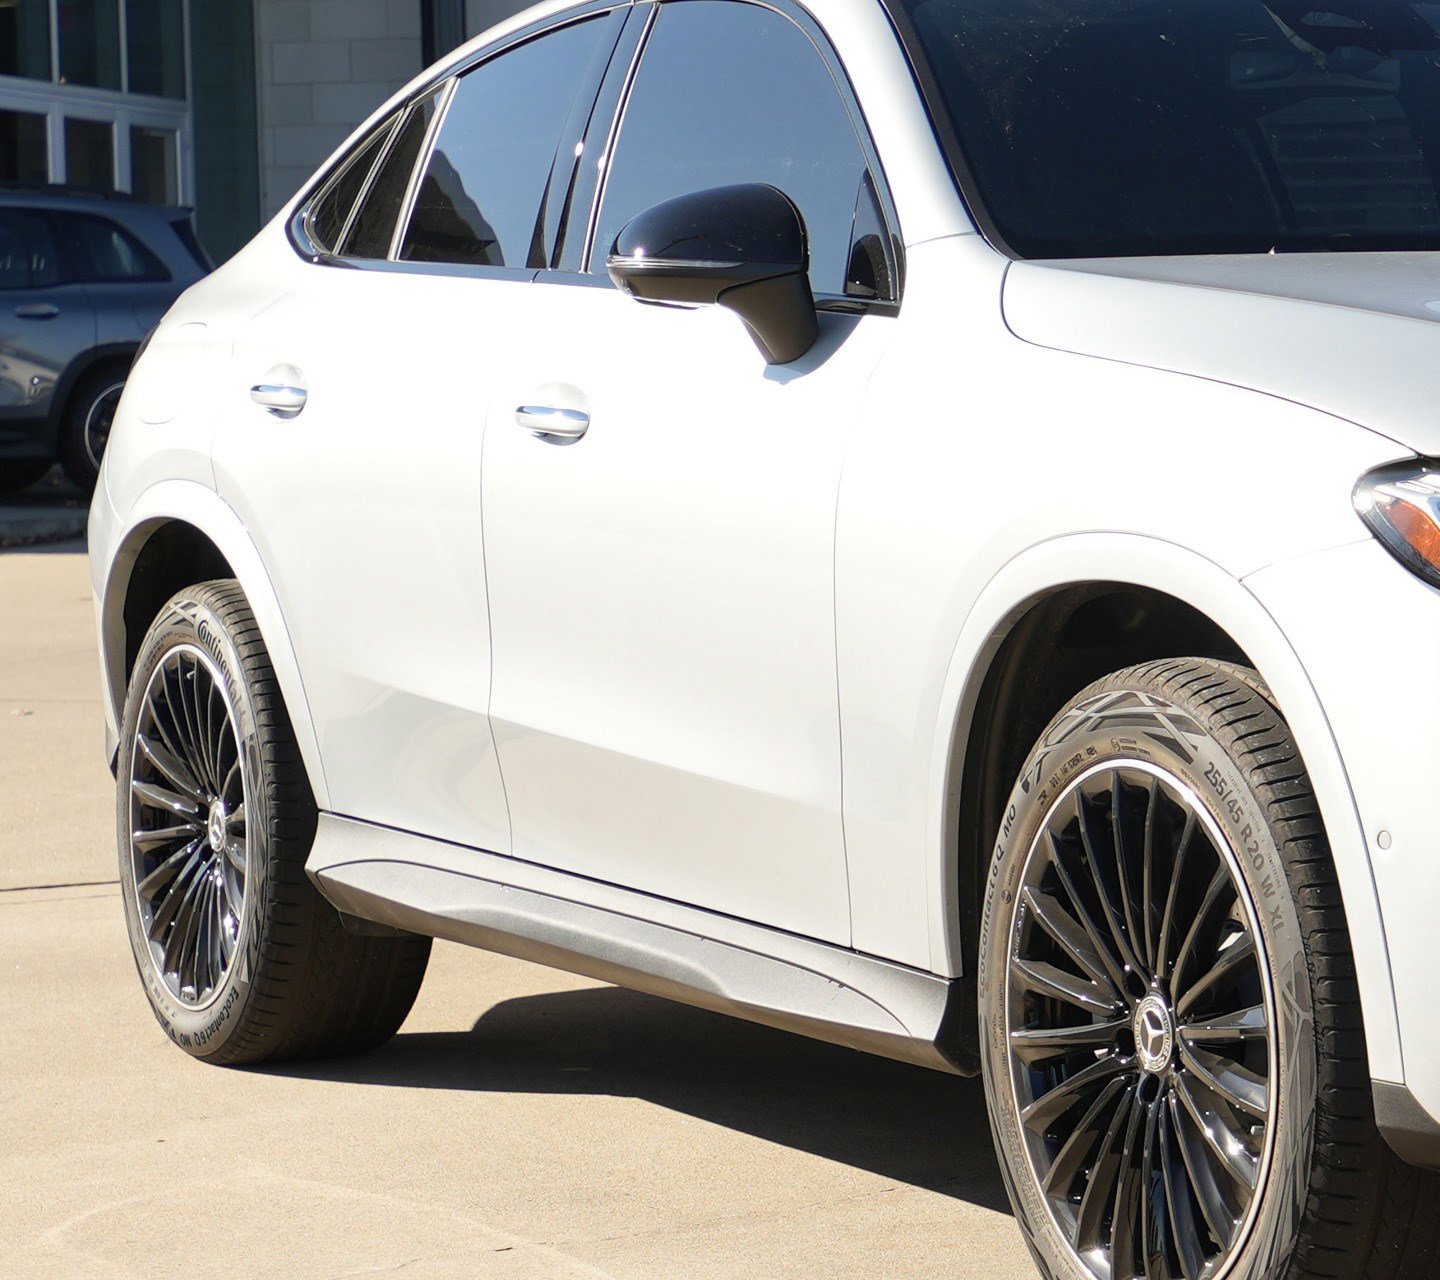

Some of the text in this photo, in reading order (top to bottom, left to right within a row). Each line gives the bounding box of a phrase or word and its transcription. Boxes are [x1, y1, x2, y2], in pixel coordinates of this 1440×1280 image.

[197, 619, 242, 710] Continental
[1203, 761, 1245, 824] 255/45
[1260, 874, 1276, 899] W
[1268, 904, 1285, 938] XL
